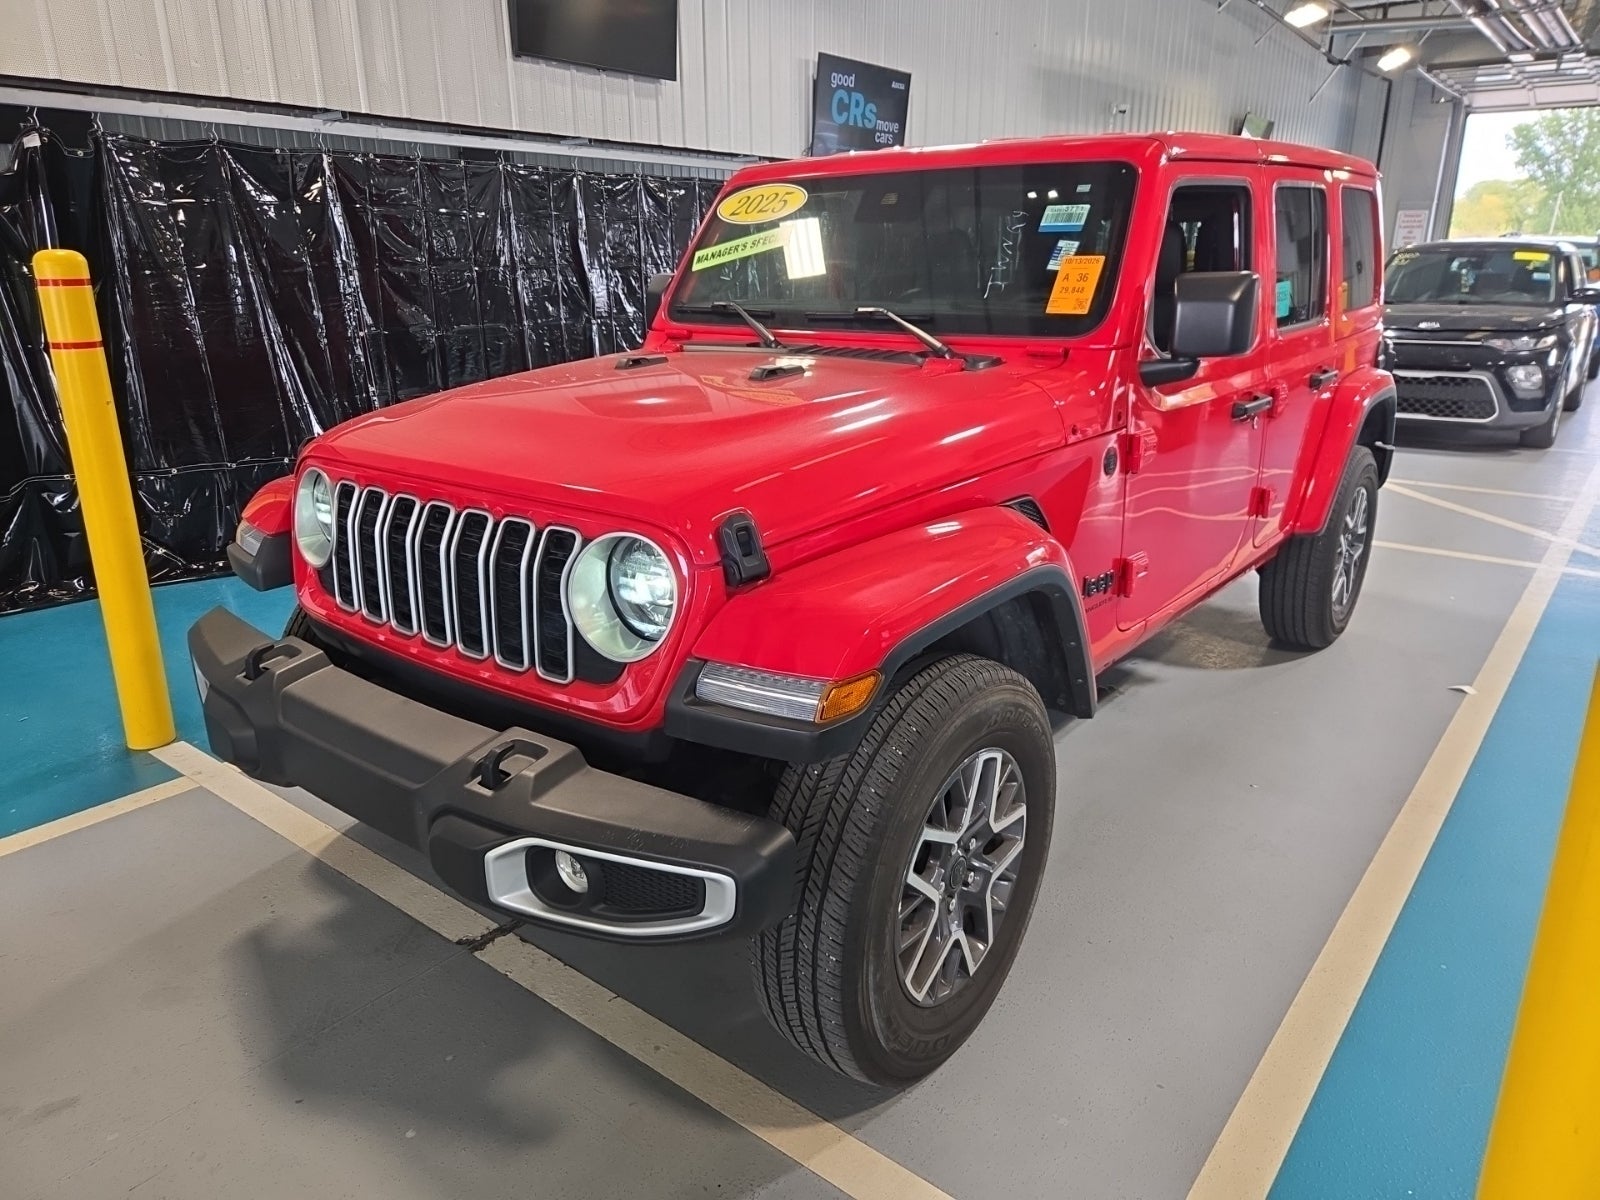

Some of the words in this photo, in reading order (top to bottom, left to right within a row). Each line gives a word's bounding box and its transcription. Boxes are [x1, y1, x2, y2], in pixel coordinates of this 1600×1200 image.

[830, 72, 855, 88] good
[831, 89, 877, 129] CRs
[876, 119, 899, 133] move
[875, 131, 893, 145] cars
[729, 191, 795, 217] 2025
[695, 242, 748, 265] MANAGER'S
[1062, 272, 1070, 282] A
[1076, 272, 1090, 283] 36
